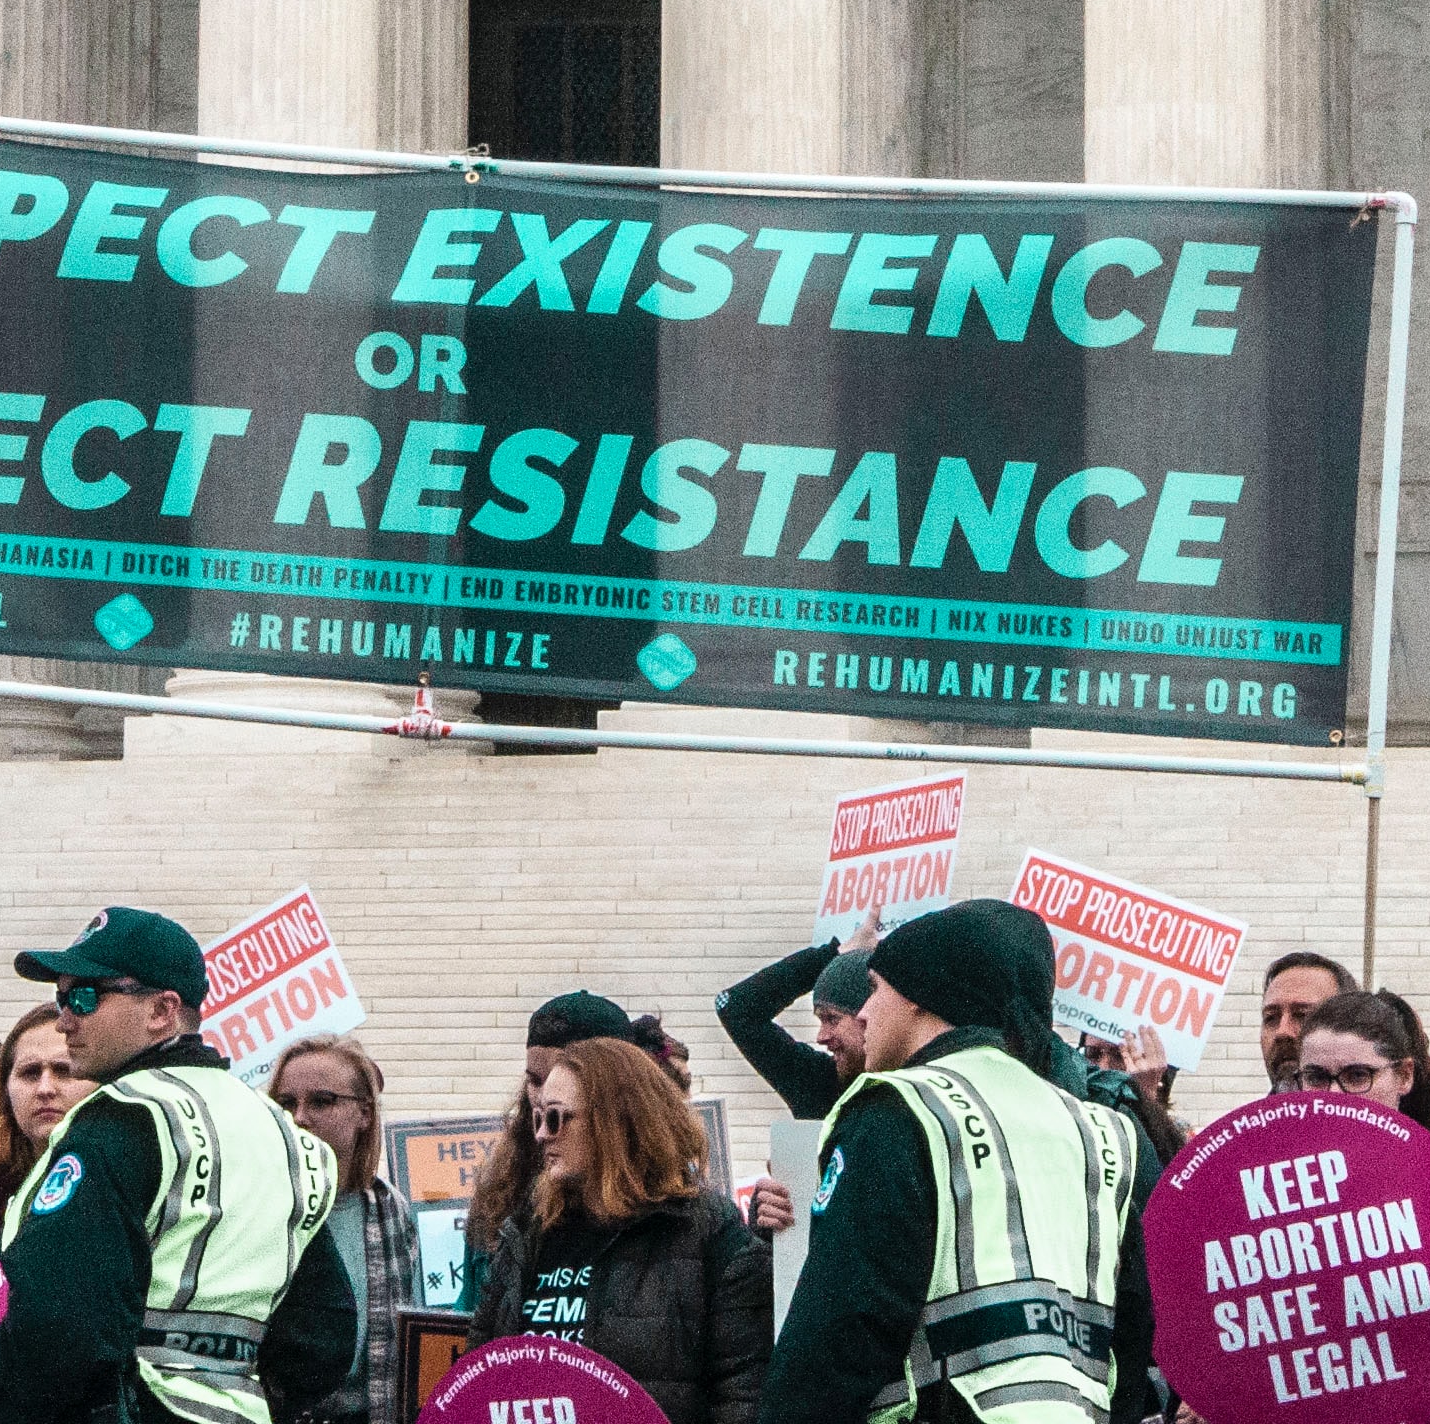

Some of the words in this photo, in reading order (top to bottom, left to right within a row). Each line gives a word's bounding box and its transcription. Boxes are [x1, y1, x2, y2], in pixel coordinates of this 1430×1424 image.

[392, 206, 1262, 357] EXISTENCE
[355, 331, 467, 395] OR
[273, 413, 1245, 587] RESISTANCE
[121, 552, 191, 578] DITCH
[201, 556, 246, 582] THE
[250, 561, 324, 588] DEATH
[333, 567, 434, 595] PENALTY
[460, 575, 504, 599] END
[514, 579, 651, 611] EMBRYONIC
[661, 590, 721, 615] STEM
[730, 594, 784, 620] CELL
[796, 600, 920, 629] RESEARCH
[947, 610, 988, 633] NIX
[997, 613, 1073, 638] NUKES
[1100, 619, 1165, 645] UNDO
[1174, 624, 1263, 652] UNJUST
[1273, 630, 1325, 655] WAR
[229, 612, 550, 670] #REHUMANIZE
[773, 648, 1299, 721] REHUMANIZEINTL.ORG
[832, 804, 871, 854] STOP
[868, 784, 962, 847] PROSECUTING
[820, 848, 953, 918] ABORTION
[1018, 864, 1085, 919] STOP
[1077, 885, 1237, 977] PROSECUTING
[1053, 936, 1215, 1039] ORTION
[176, 1098, 209, 1208] USCP
[927, 1075, 991, 1169] USCP
[1170, 1131, 1235, 1191] Feminist
[1232, 1101, 1308, 1135] Majority
[1312, 1098, 1412, 1143] Foundation
[300, 1136, 318, 1231] OLICE
[1239, 1149, 1349, 1222] KEEP
[1203, 1198, 1422, 1294] ABORTION
[1213, 1283, 1327, 1354] SAFE
[435, 1360, 486, 1411] Feminist
[485, 1344, 545, 1368] Majority
[548, 1345, 630, 1399] Foundation
[1268, 1331, 1407, 1405] LEGAL
